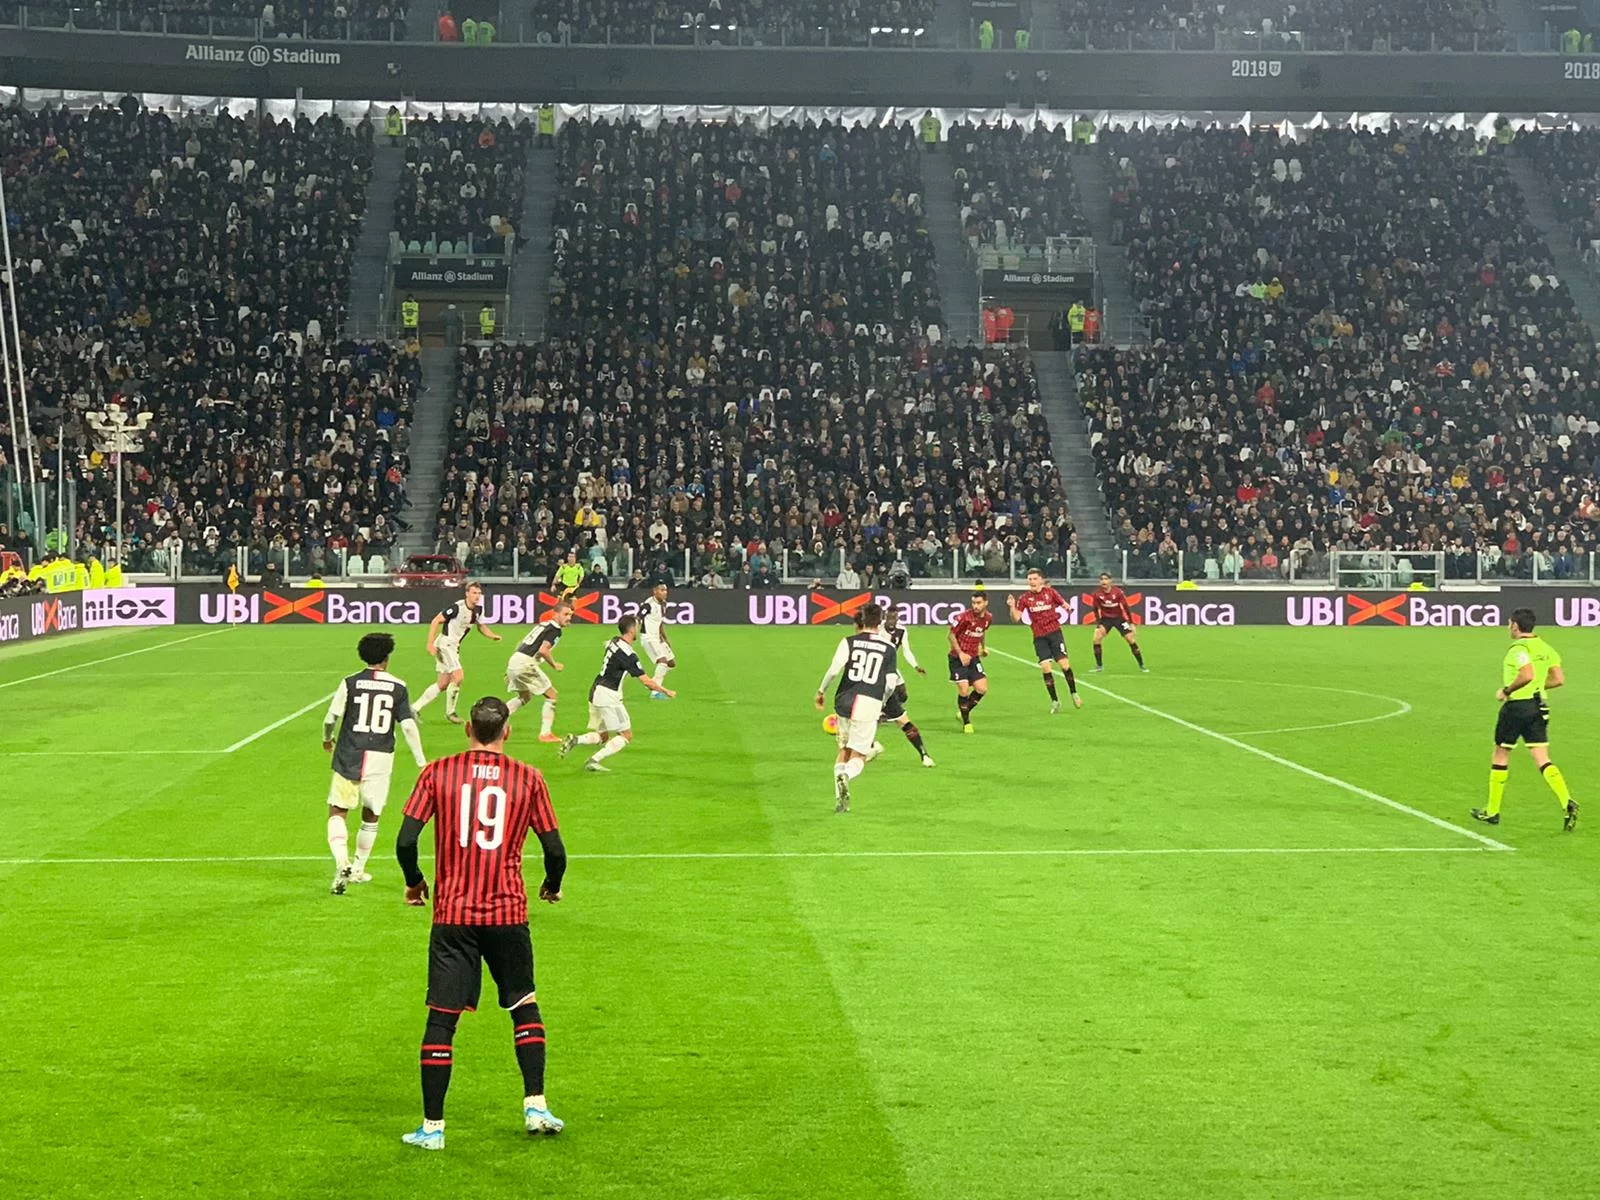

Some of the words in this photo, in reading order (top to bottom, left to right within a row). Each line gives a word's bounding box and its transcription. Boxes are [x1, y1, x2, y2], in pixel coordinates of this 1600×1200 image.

[185, 44, 245, 62] Allianz
[272, 48, 341, 65] Stadium
[1231, 59, 1267, 77] 2019
[1564, 62, 1600, 80] 2018
[411, 271, 443, 281] Allianz
[456, 271, 494, 281] Stadium
[1003, 274, 1030, 283] Allianz
[1042, 274, 1075, 283] Stadium
[31, 602, 45, 636] UBI
[57, 599, 77, 631] Banca
[84, 594, 168, 621] nilox
[199, 593, 259, 624] UBI
[327, 593, 421, 624] Banca
[475, 594, 535, 624] UBI
[748, 595, 808, 625] UBI
[1144, 595, 1236, 626] Banca
[1286, 596, 1344, 626] UBI
[1409, 597, 1501, 627] Banca
[848, 649, 884, 685] 30
[352, 692, 394, 734] 16
[472, 764, 500, 780] THEO
[460, 783, 507, 850] 19
